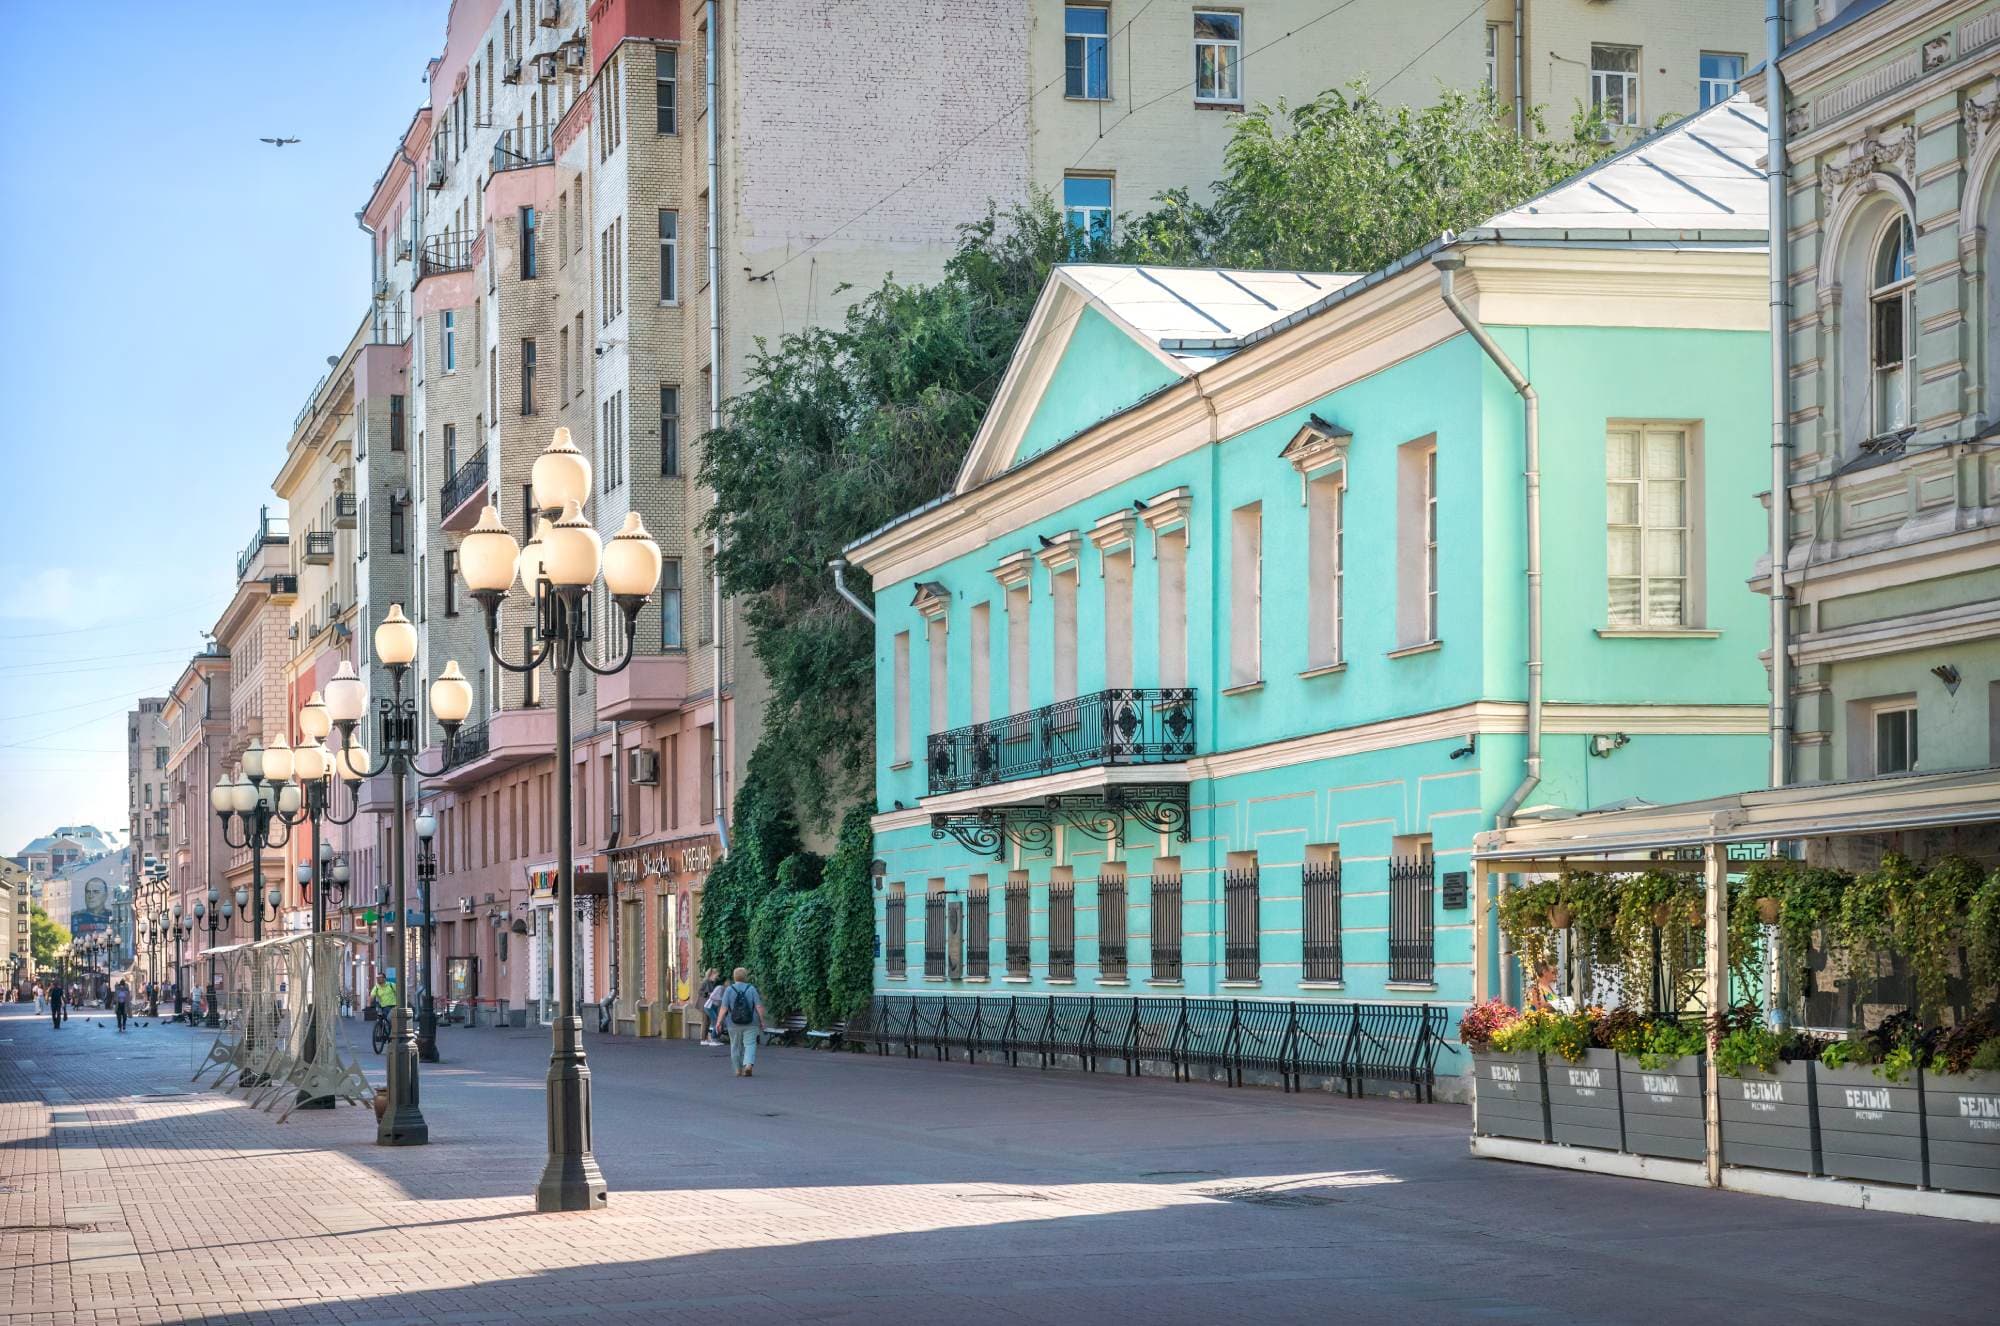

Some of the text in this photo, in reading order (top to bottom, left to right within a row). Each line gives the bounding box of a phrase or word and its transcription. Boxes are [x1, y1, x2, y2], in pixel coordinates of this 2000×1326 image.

[1568, 1068, 1601, 1088] БЕЛЫЙ
[1642, 1074, 1679, 1094] БЕЛЫЙ
[1742, 1081, 1784, 1101] БЕЛЫЙ
[1845, 1087, 1892, 1109] БЕЛЫЙ
[1855, 1110, 1884, 1121] РЕСТОРАН
[1958, 1096, 2000, 1118] БЕЛЫ
